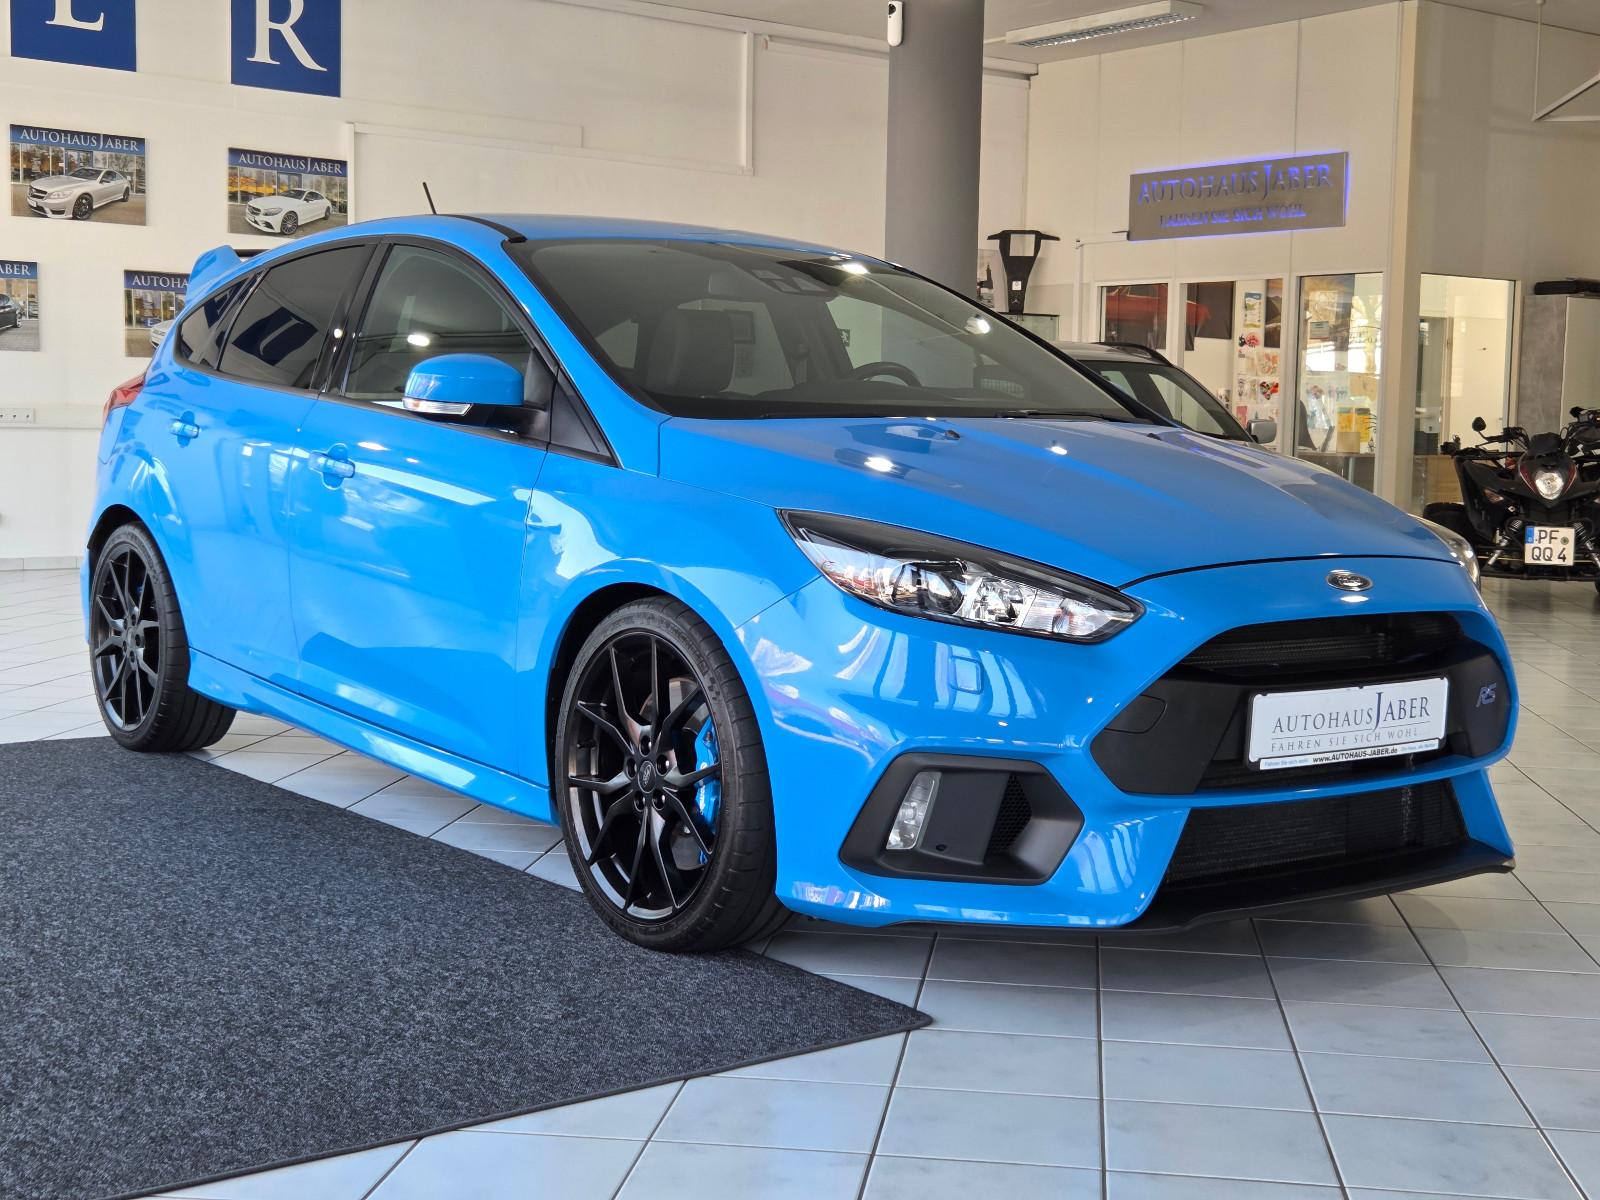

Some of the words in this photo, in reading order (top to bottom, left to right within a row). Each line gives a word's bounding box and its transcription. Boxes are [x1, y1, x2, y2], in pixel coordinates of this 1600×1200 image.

[246, 0, 328, 72] R
[1537, 529, 1560, 544] PF
[1531, 546, 1553, 562] QQ
[1557, 547, 1567, 563] 4
[1271, 738, 1321, 753] FAHREN
[1329, 735, 1347, 747] SIE
[1353, 731, 1381, 744] SICH
[1312, 746, 1398, 764] www.AUTOHAUS-JABER.de
